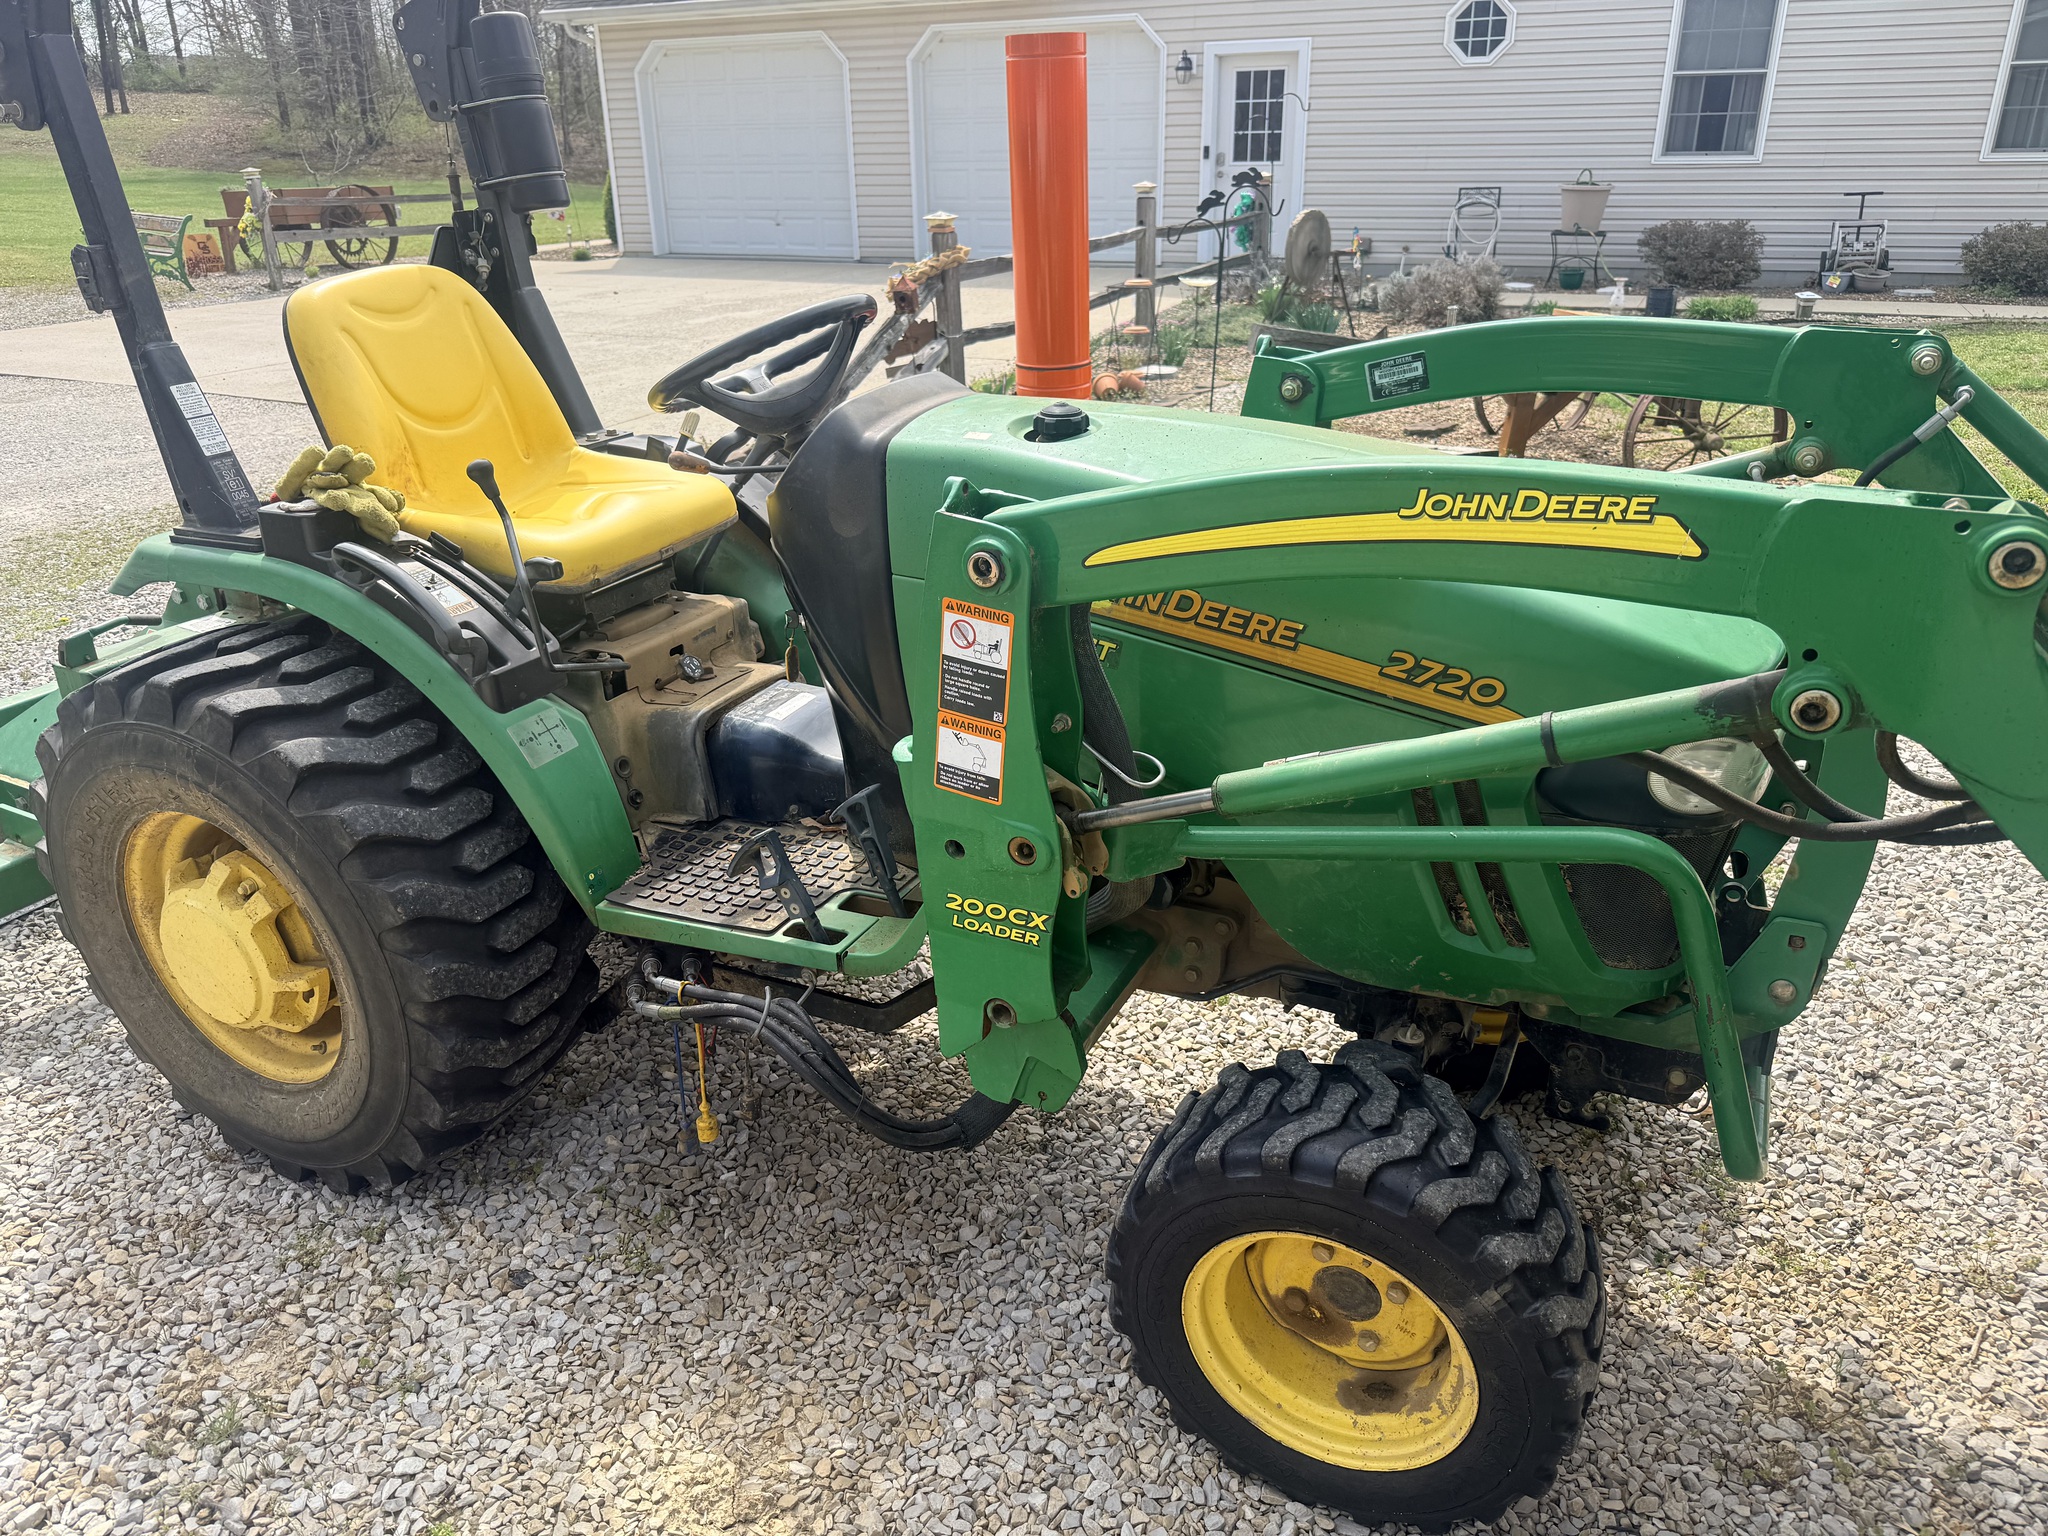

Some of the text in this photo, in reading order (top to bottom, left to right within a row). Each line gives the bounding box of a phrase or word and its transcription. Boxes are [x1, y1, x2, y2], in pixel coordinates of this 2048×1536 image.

[231, 489, 250, 501] 0045
[1398, 488, 1658, 520] JOHN DEERE
[955, 602, 1010, 624] WARNING
[1164, 589, 1304, 649] DEERE
[1380, 650, 1507, 705] 2720
[950, 717, 1002, 739] WARNING
[945, 892, 1050, 932] 200CX
[952, 914, 1040, 946] LOADER
